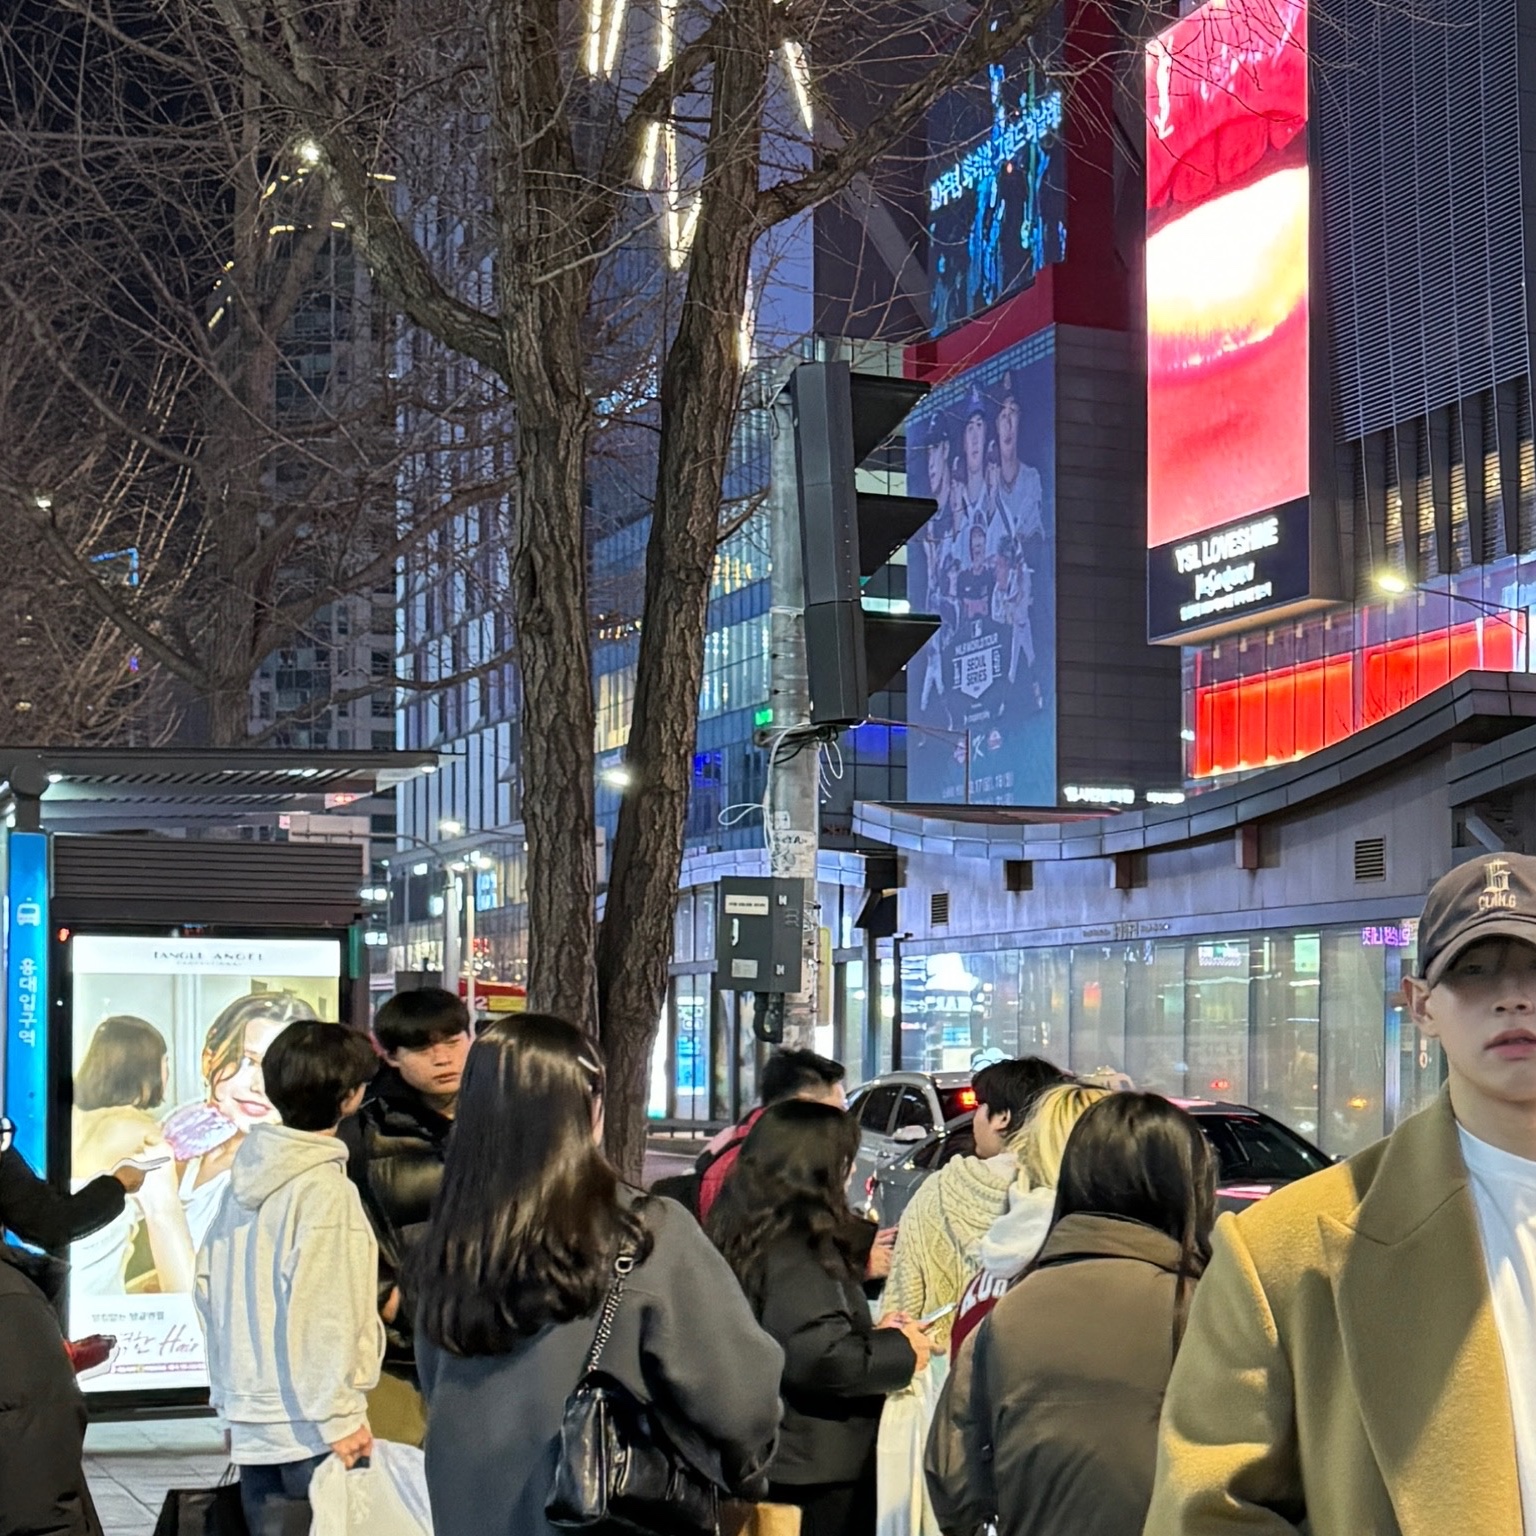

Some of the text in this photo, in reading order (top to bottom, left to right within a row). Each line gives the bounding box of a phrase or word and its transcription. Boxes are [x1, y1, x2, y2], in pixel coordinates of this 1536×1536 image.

[967, 655, 987, 671] SEOUL
[966, 669, 988, 687] SERIES
[18, 957, 38, 1049] 홍대입구역
